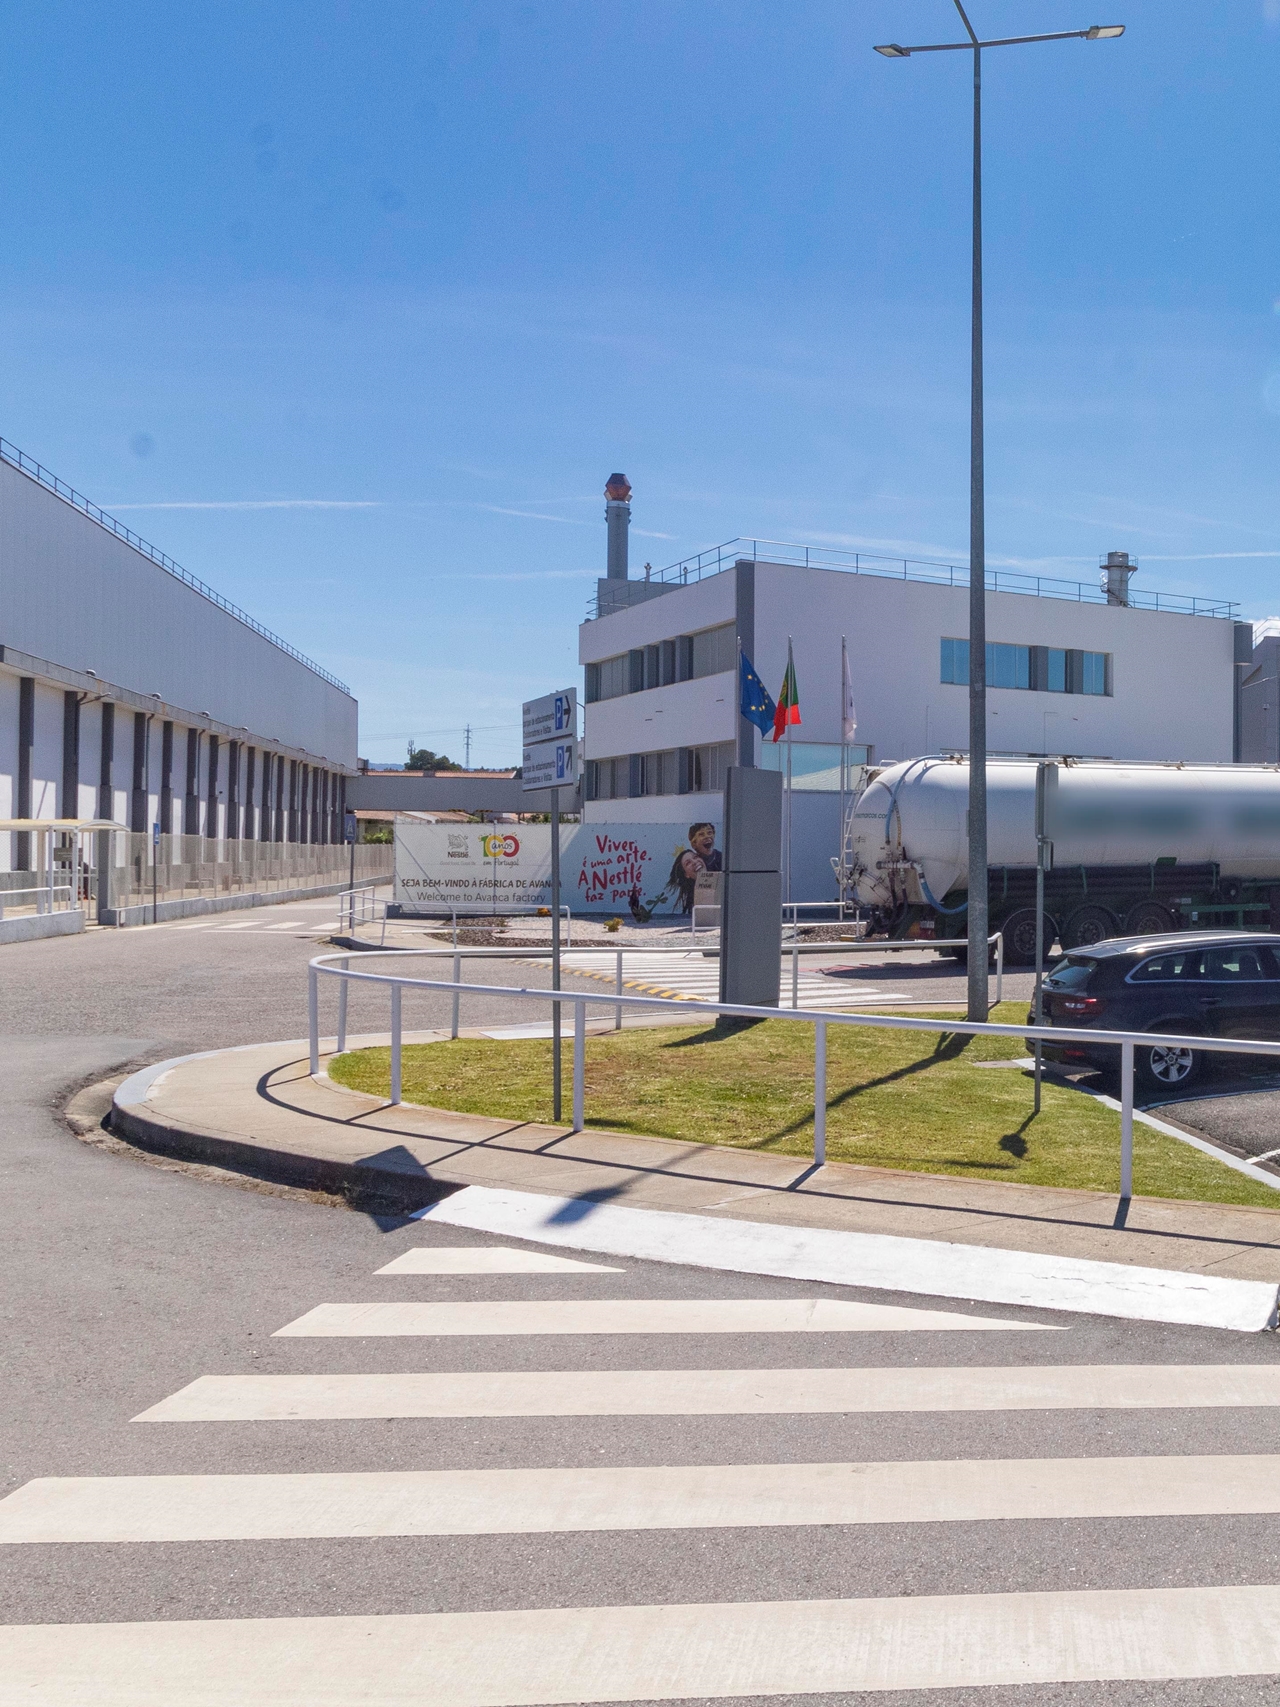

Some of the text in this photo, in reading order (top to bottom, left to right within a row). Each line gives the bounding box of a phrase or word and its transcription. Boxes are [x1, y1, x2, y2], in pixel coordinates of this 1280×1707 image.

[491, 842, 513, 850] anos
[595, 834, 635, 854] Viver
[494, 858, 520, 869] Portugal
[582, 845, 652, 869] é uma arte.
[401, 877, 562, 888] SEJA BEM-VINDO À FÁBRICA DE AVAN
[577, 862, 643, 892] A Nestlé
[416, 891, 546, 905] Welcome to Avanca factory
[584, 881, 647, 904] faz parte.
